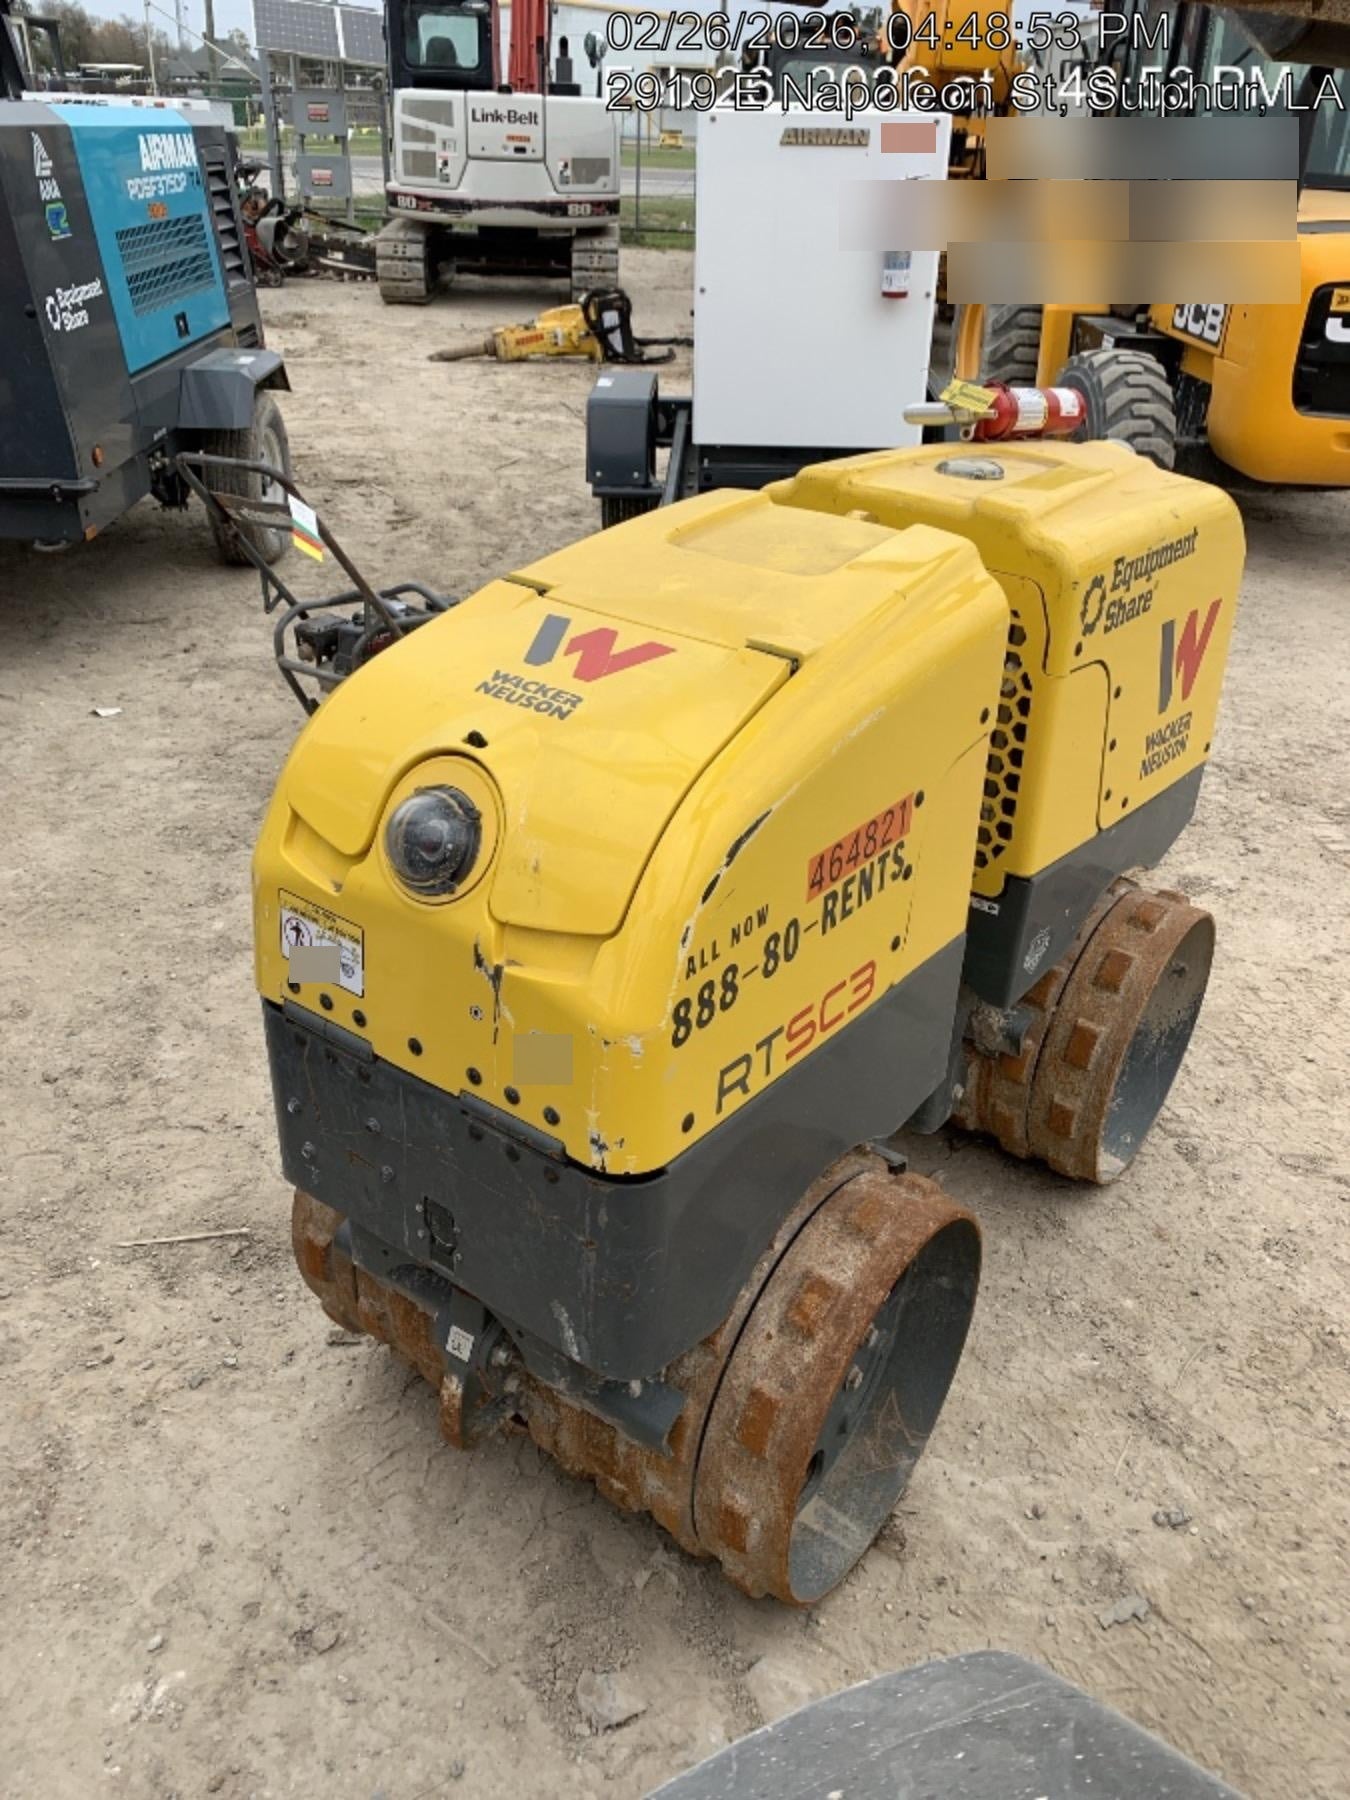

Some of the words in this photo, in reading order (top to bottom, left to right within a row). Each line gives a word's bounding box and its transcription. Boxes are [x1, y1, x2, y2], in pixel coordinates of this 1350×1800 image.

[471, 108, 538, 126] Link-Belt
[780, 128, 870, 147] AIRMAN
[138, 133, 198, 172] AIRMAN
[1173, 304, 1224, 343] JCB
[1110, 527, 1198, 593] Equipment
[1103, 586, 1153, 635] Share
[474, 681, 573, 721] NEUSON
[490, 669, 584, 709] WACKER
[1145, 711, 1192, 754] WACKER
[1139, 733, 1189, 780] NEUSON
[810, 799, 907, 893] 464821
[730, 903, 768, 948] NOW
[716, 959, 876, 1115] RTSC3
